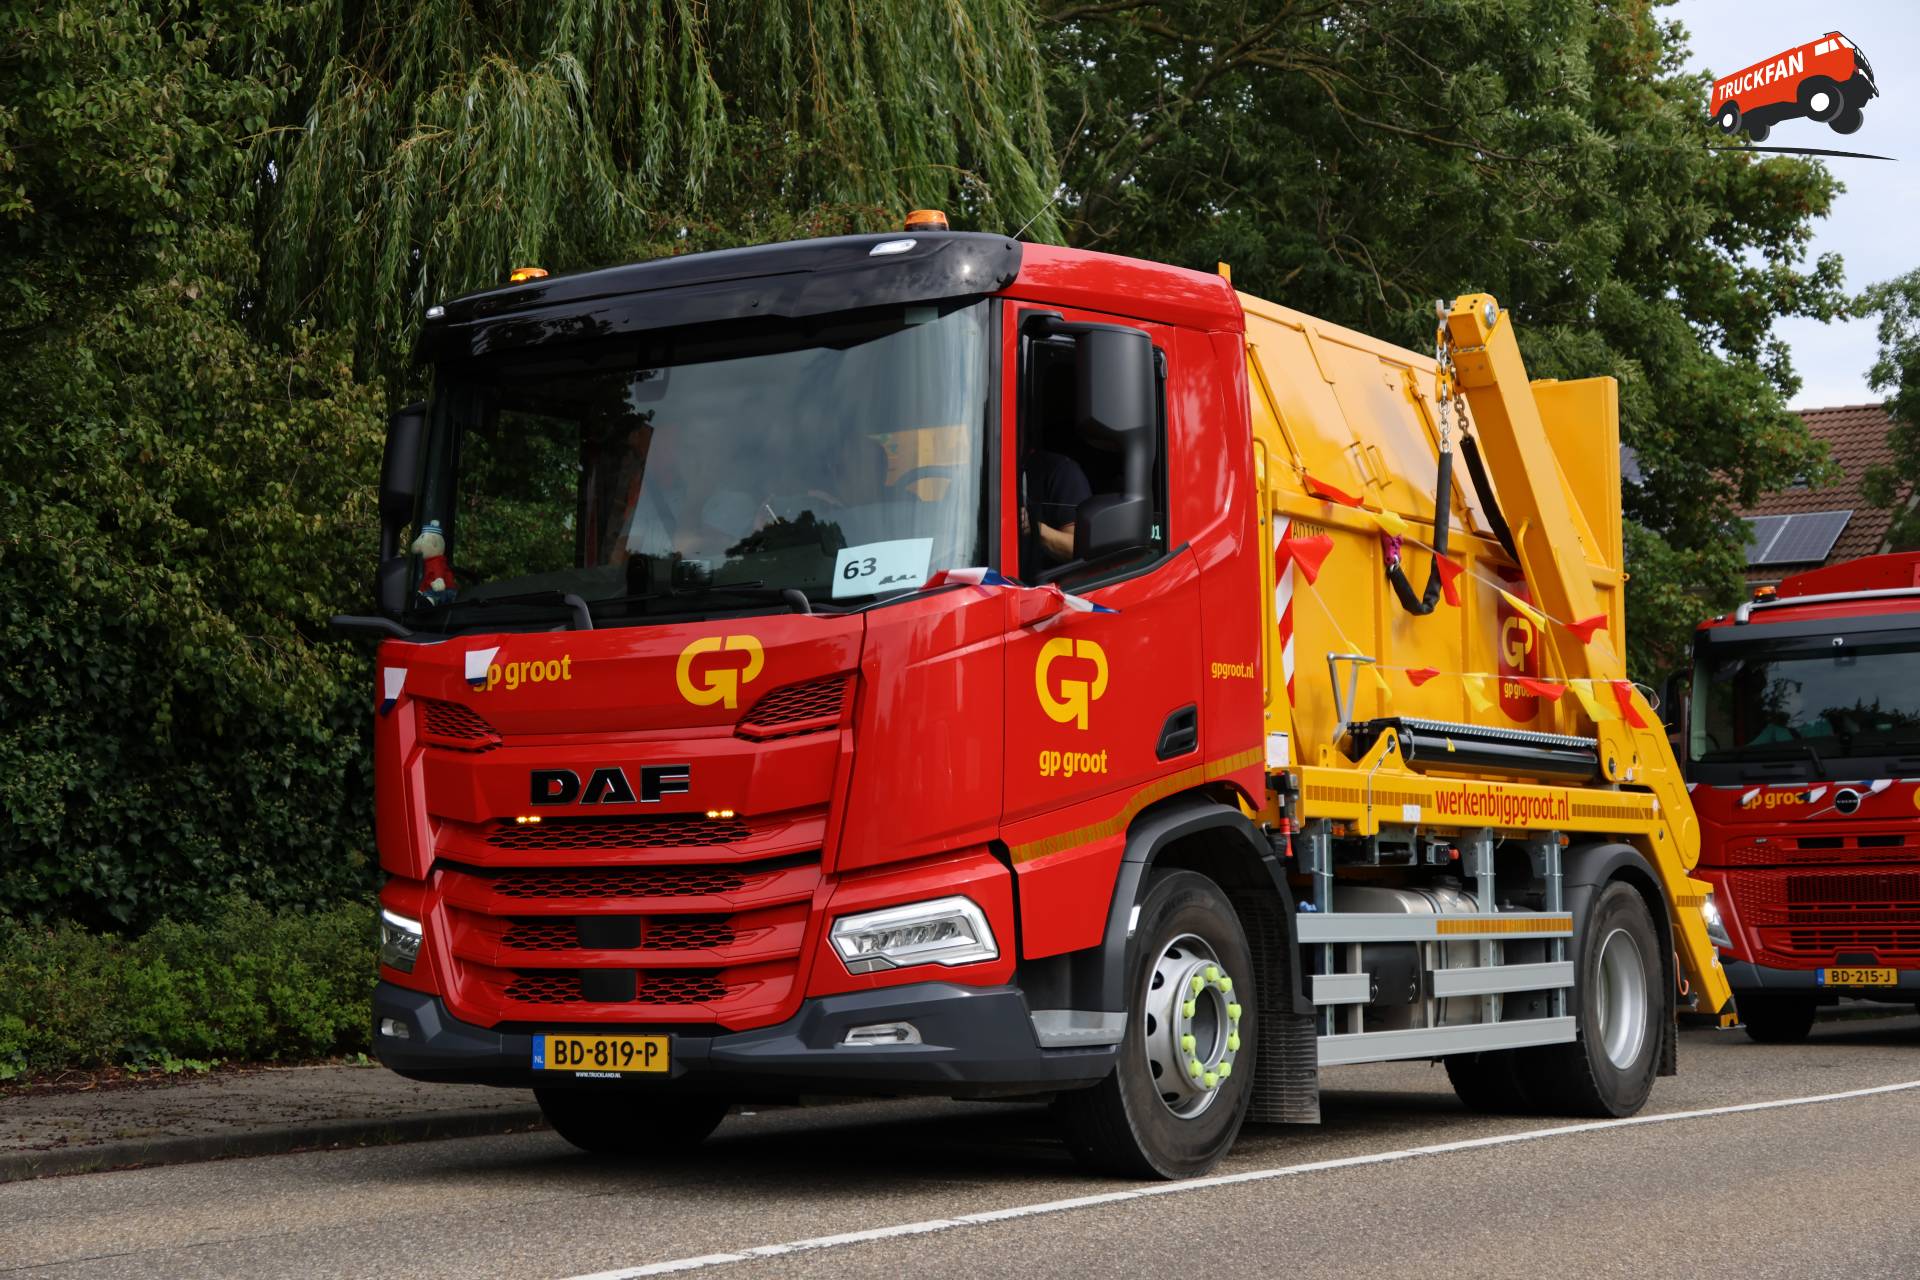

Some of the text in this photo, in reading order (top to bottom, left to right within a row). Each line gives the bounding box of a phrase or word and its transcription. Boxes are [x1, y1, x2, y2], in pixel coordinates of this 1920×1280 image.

[843, 557, 877, 580] 63
[504, 653, 572, 690] groot
[1211, 661, 1255, 680] gpgroot.nl
[1039, 749, 1108, 778] gp groot
[529, 763, 691, 807] DAF
[1435, 783, 1570, 826] werkenbijgpgroot.nl
[1831, 970, 1891, 983] BD-215-J
[534, 1039, 659, 1067] NL BD-819-P
[575, 1071, 623, 1079] WWW.TRUCKLAND.NL
